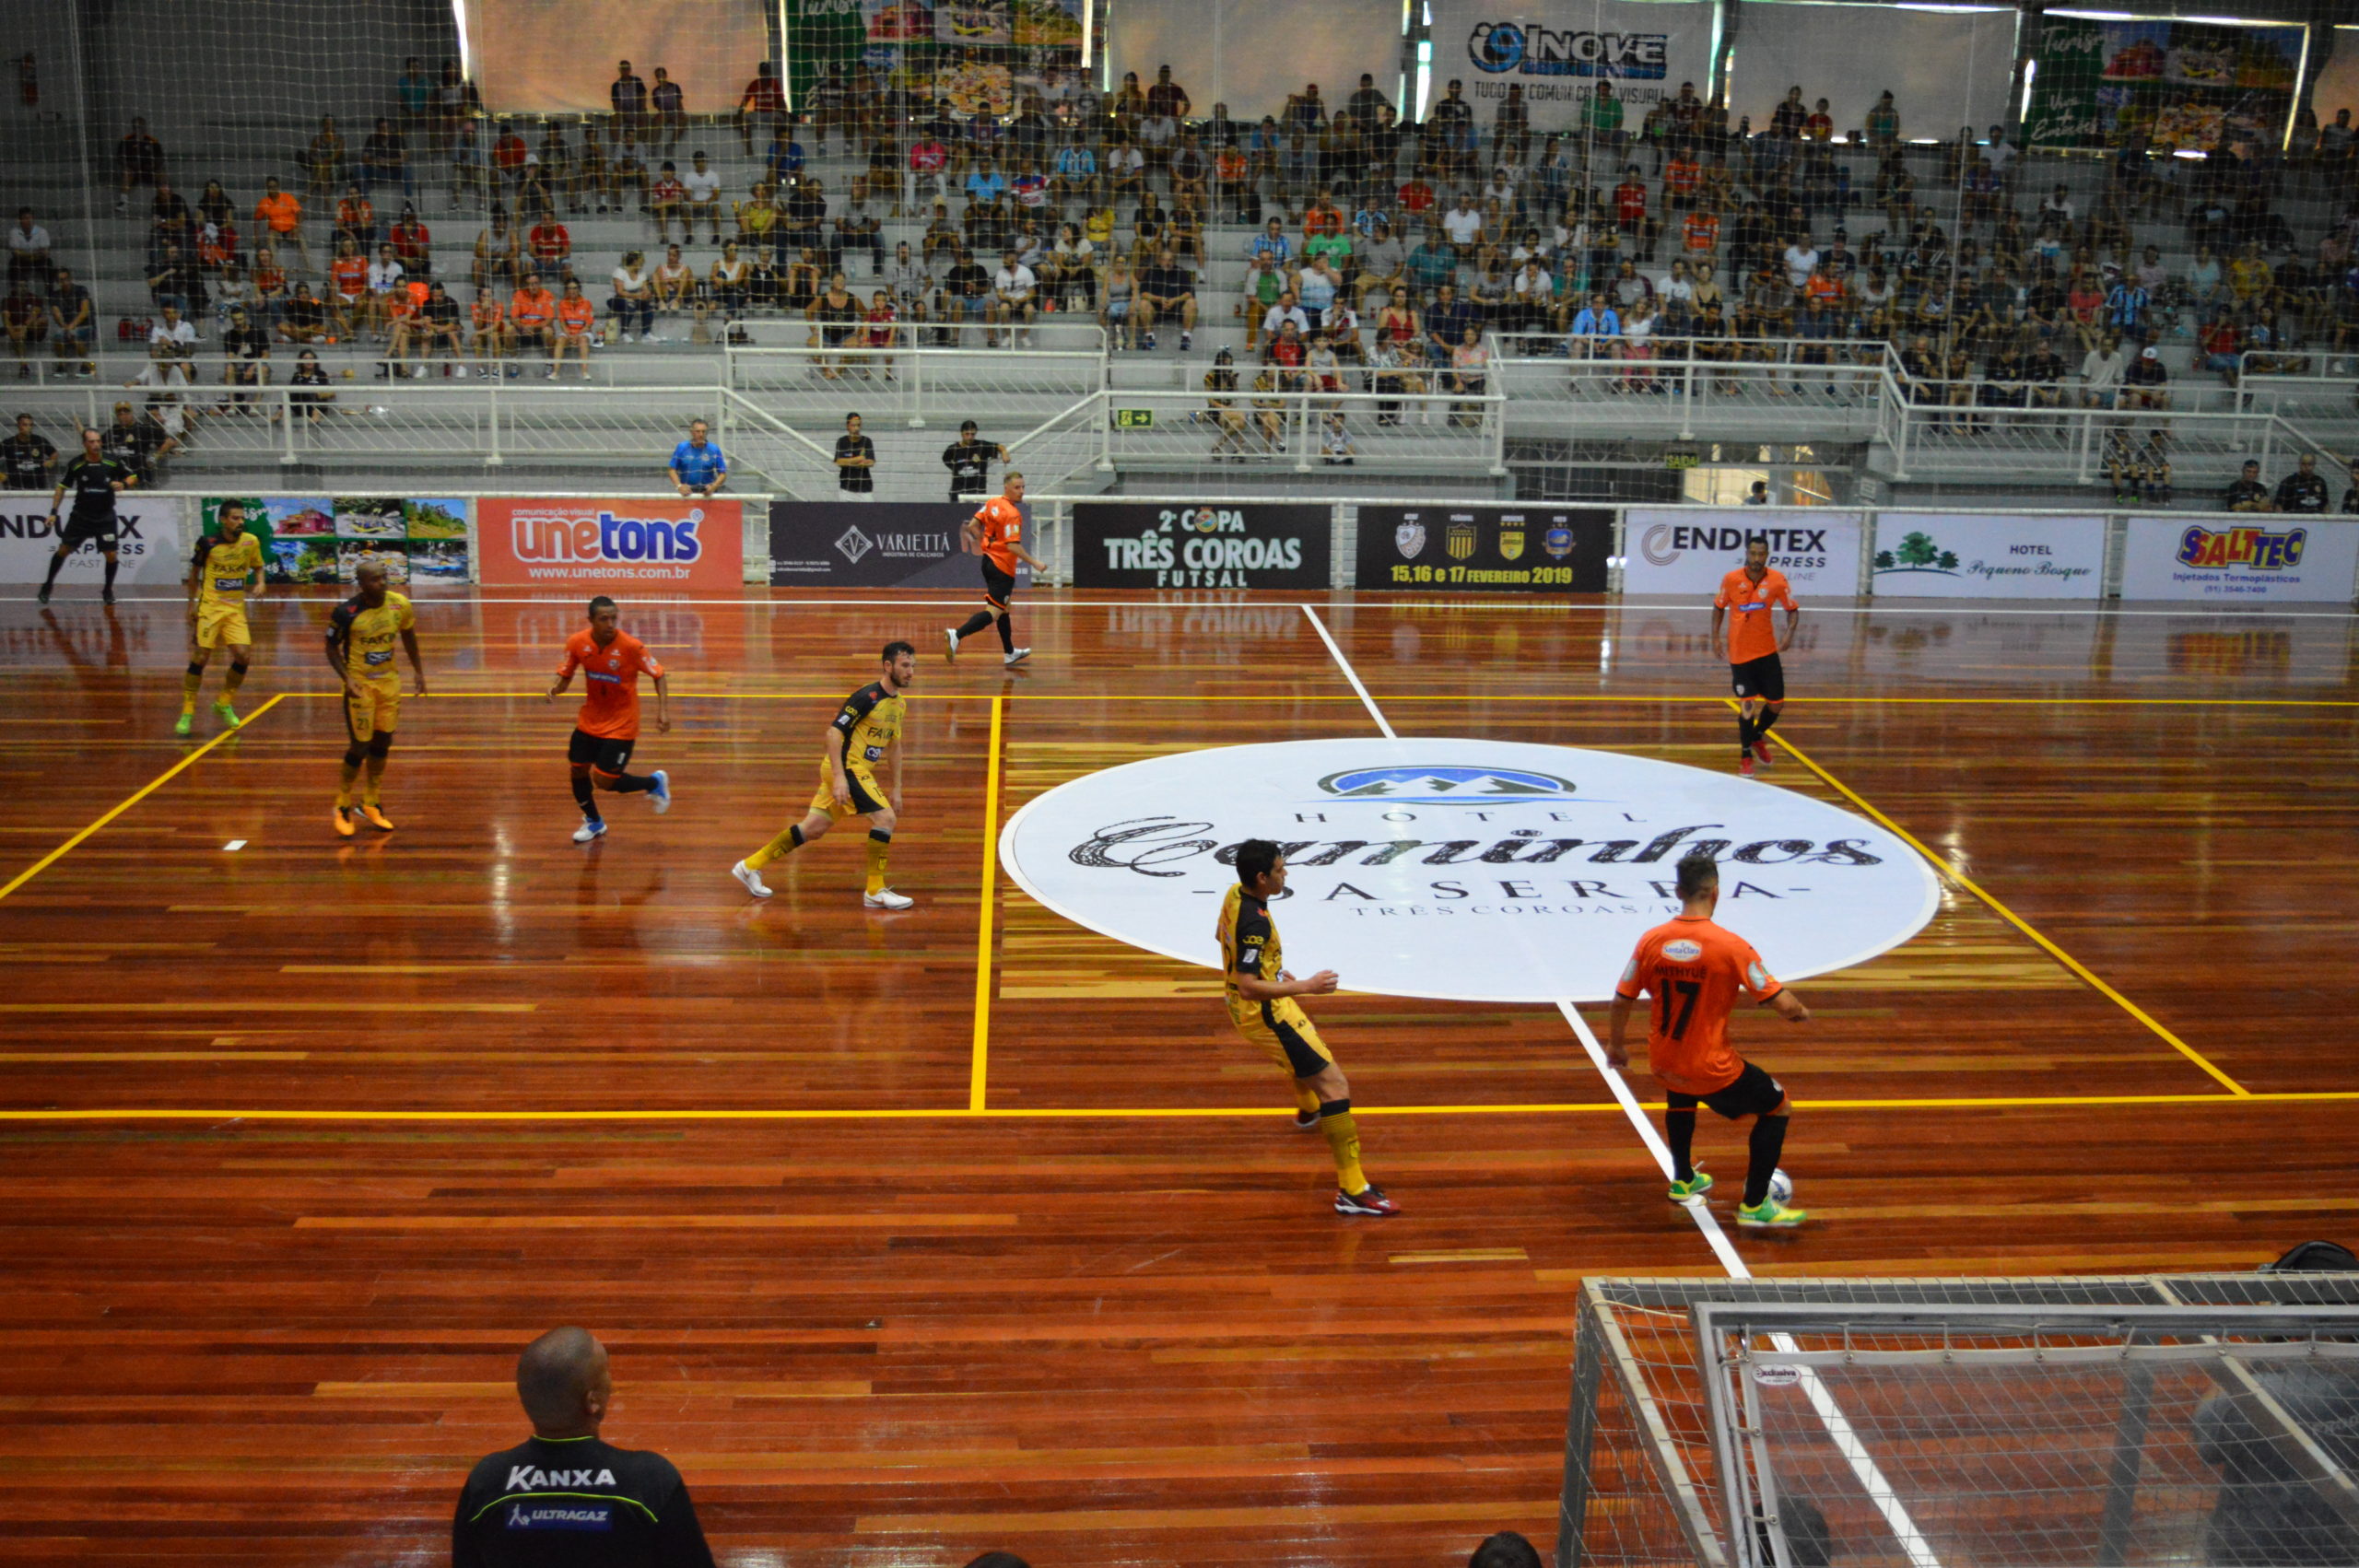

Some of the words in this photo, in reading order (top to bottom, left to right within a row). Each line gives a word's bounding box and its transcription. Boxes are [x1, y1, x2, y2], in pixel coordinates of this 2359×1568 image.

[512, 508, 569, 517] comunicação
[570, 508, 594, 516] visual
[511, 510, 702, 564] unetons
[1103, 529, 1175, 569] TRÊS
[1183, 538, 1302, 569] COROAS
[2009, 545, 2053, 555] HOTEL
[529, 566, 690, 579] www.unetons.com.br
[1391, 565, 1432, 582] 15,16
[1435, 568, 1446, 581] e
[1449, 567, 1466, 581] 17
[1467, 569, 1530, 583] FEVEREIRO
[1532, 567, 1573, 583] 2019
[1966, 560, 2031, 580] Pequeno
[2033, 561, 2092, 581] Bosque
[2173, 573, 2220, 582] Injetados
[1157, 570, 1248, 587] FUTSAL
[1295, 813, 1647, 823] HOTEL
[1350, 906, 1454, 917] TRÊS
[1661, 978, 1701, 1040] 17
[505, 1465, 617, 1491] KANXA
[531, 1510, 608, 1522] ULTRAGAZ
